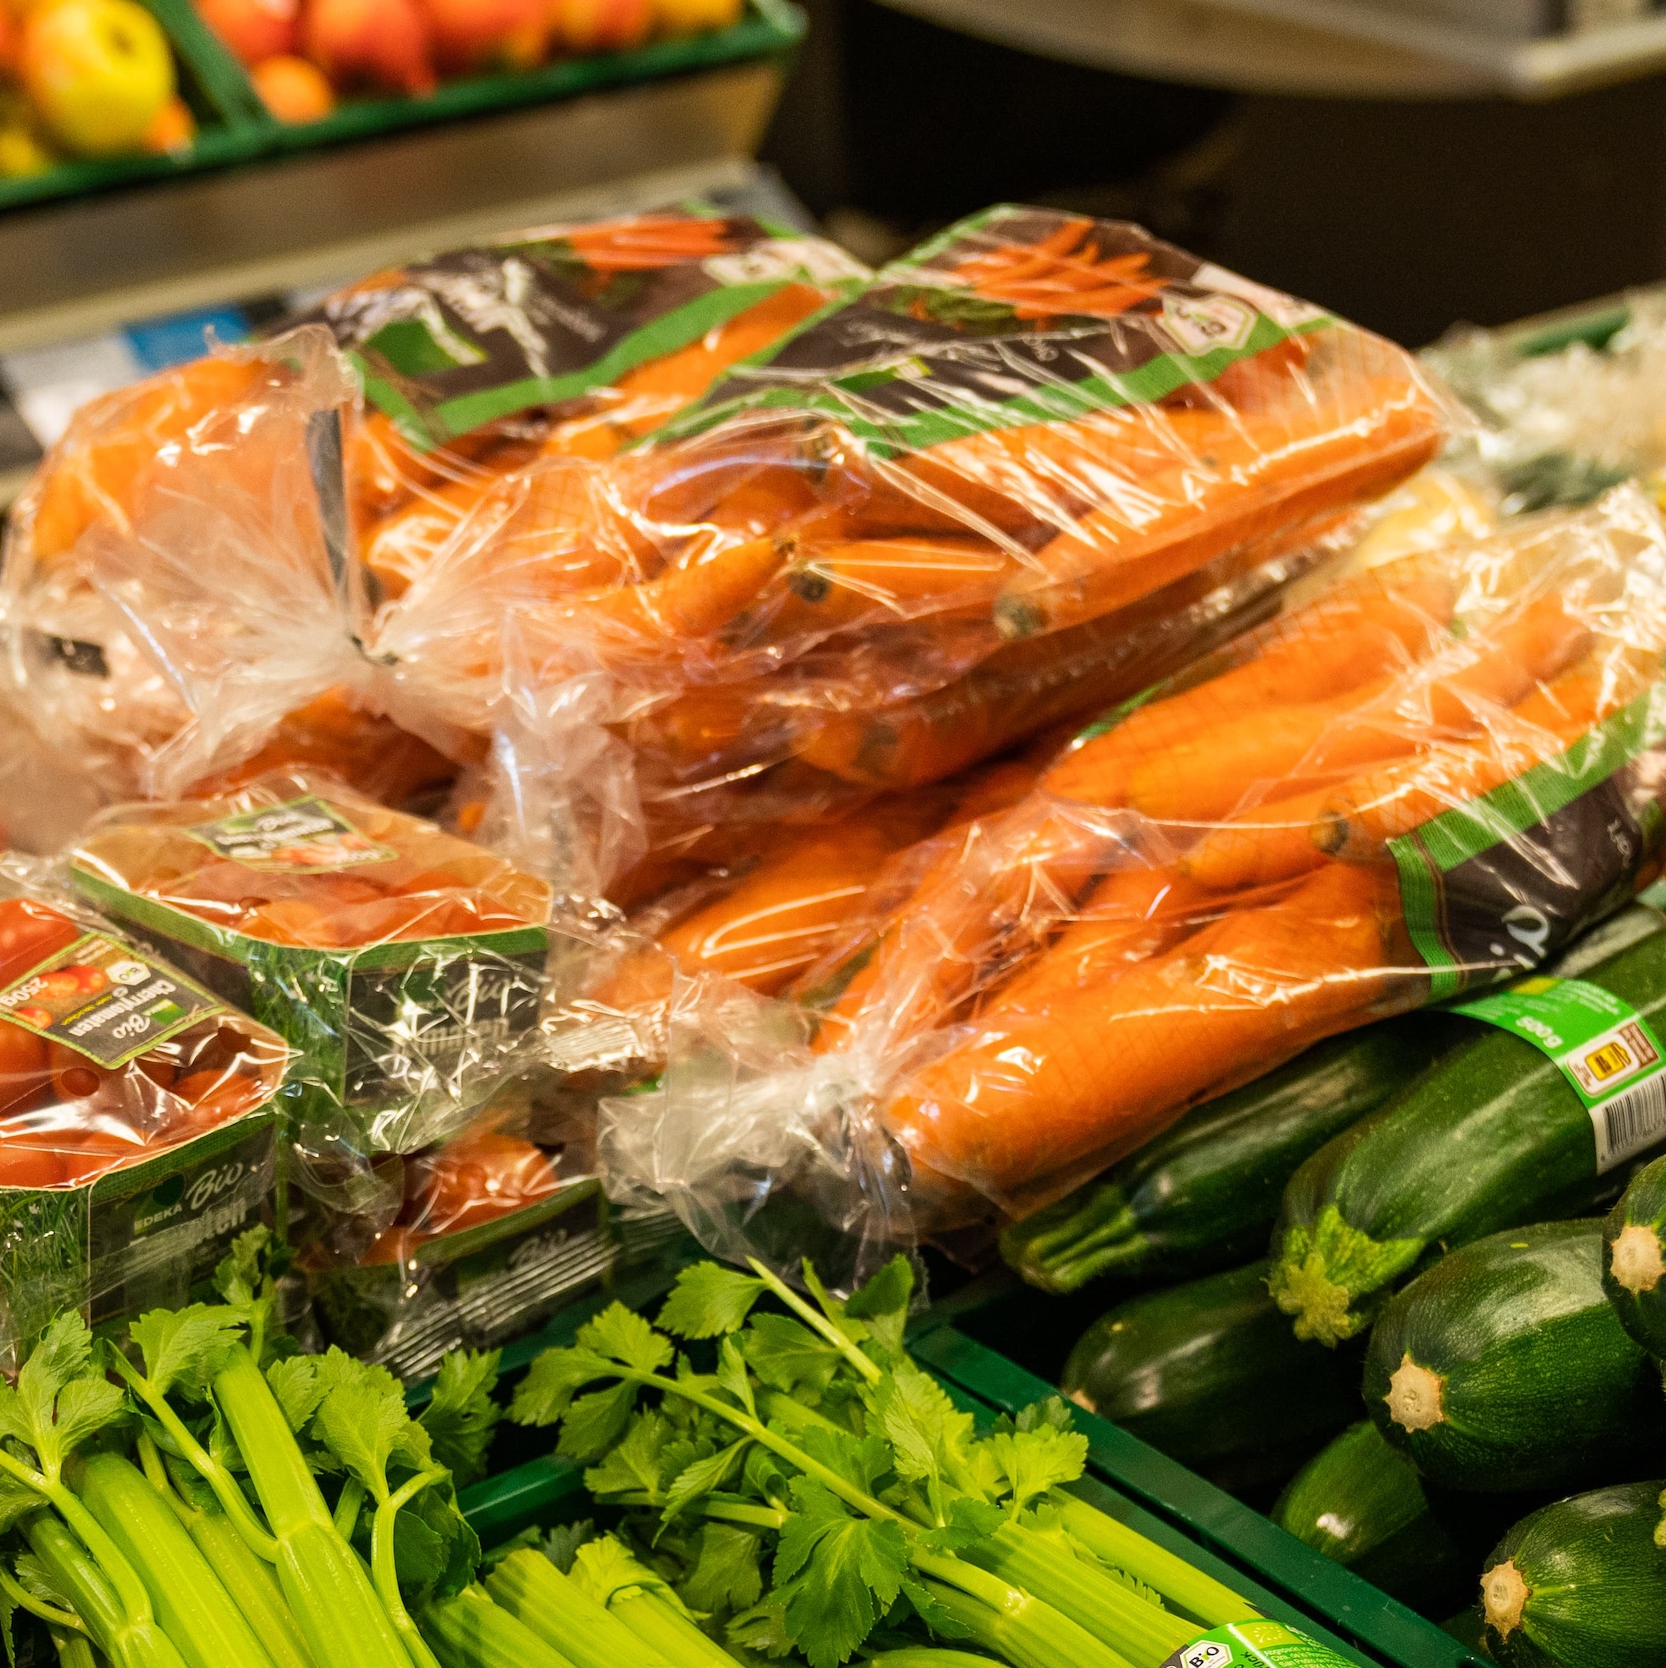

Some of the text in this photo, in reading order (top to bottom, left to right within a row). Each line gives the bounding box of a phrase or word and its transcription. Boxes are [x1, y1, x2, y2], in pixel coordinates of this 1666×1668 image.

[112, 1013, 152, 1040] Bio
[134, 1203, 183, 1232] EDEKA
[185, 1162, 244, 1211] Bio
